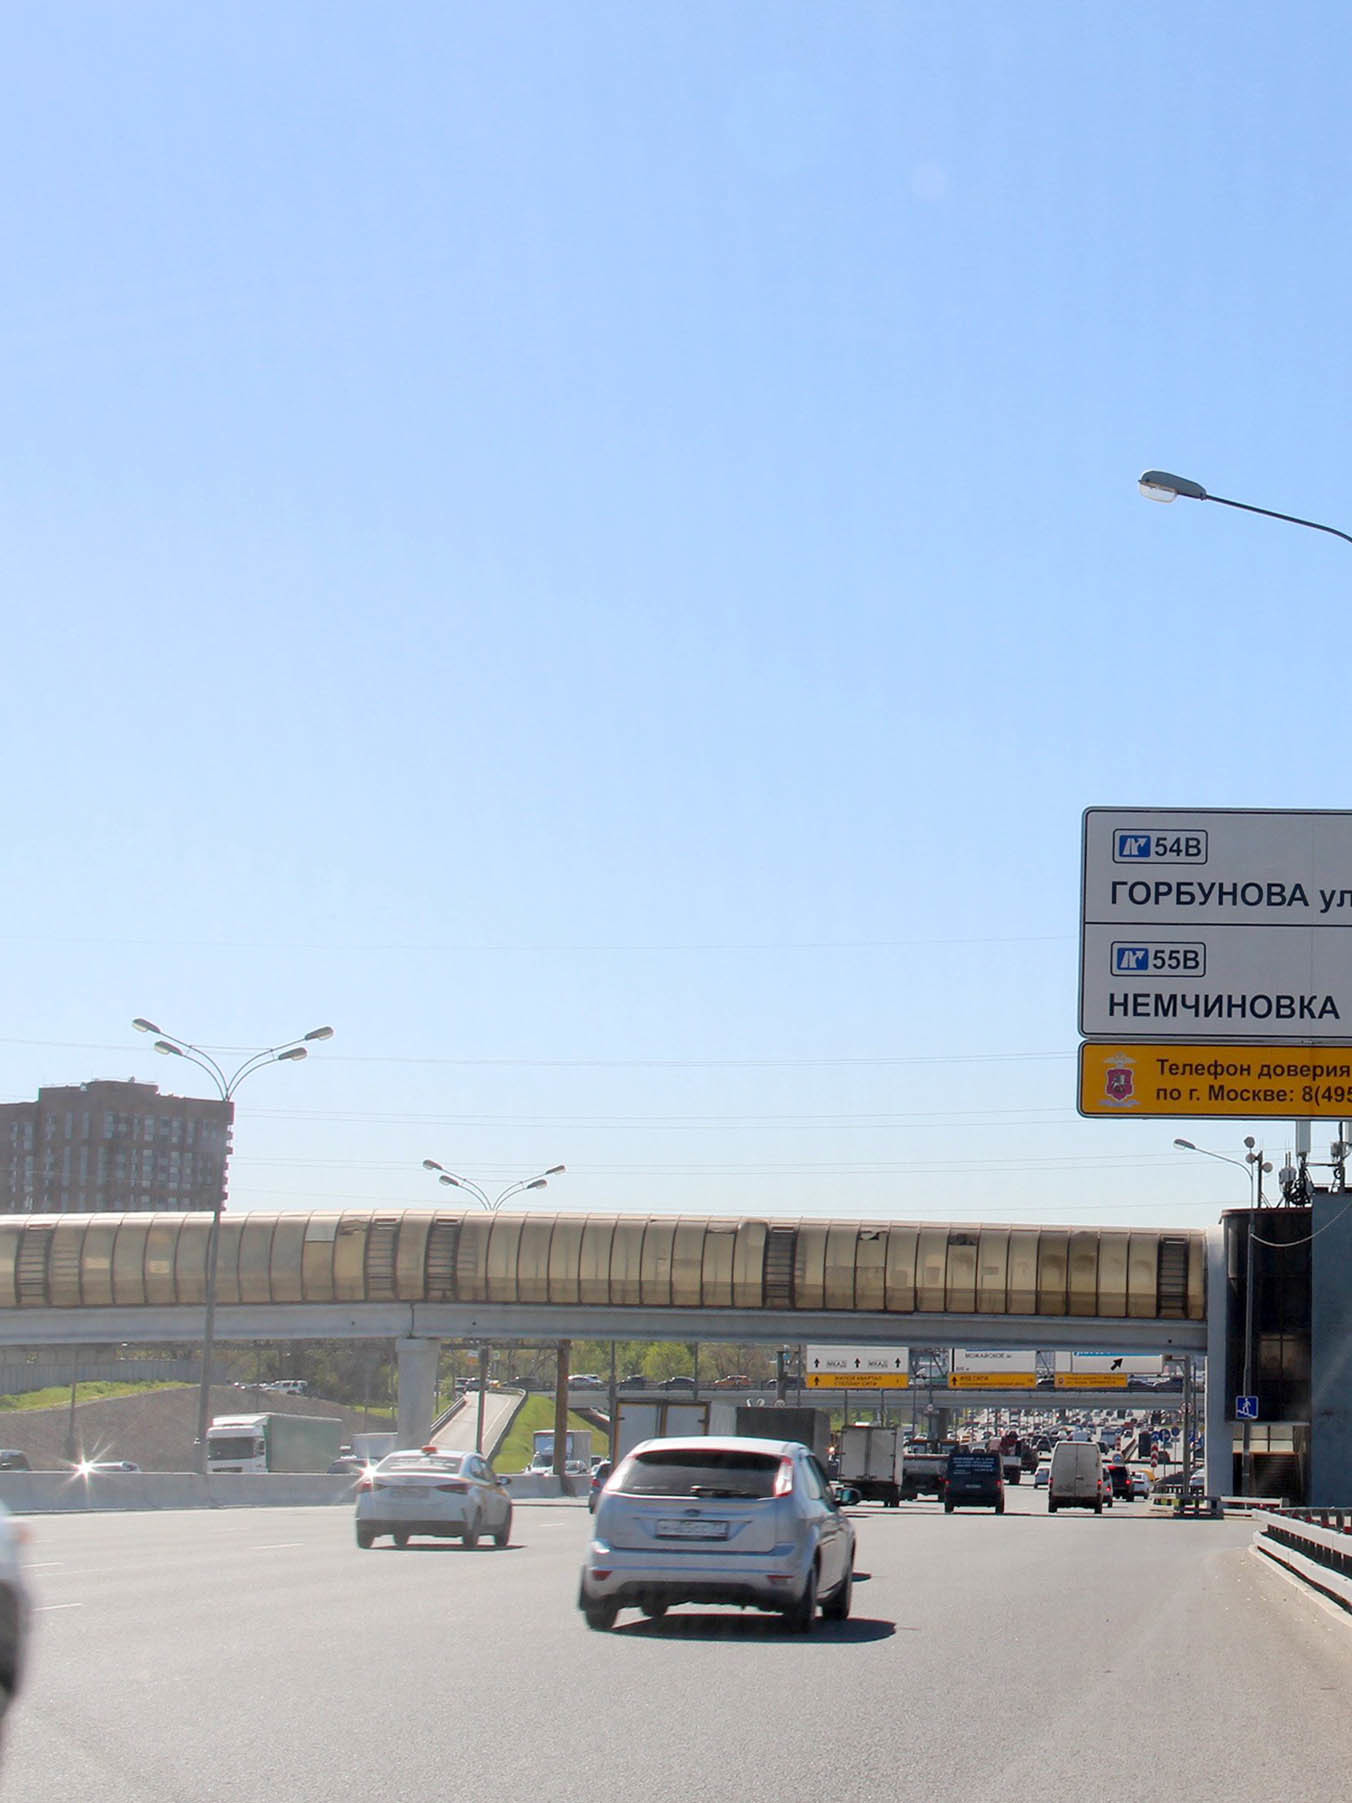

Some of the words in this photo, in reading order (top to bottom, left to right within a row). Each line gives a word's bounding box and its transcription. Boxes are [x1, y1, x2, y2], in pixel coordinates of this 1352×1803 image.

[1154, 837, 1201, 857] 54В
[1111, 881, 1309, 907] ГОРБУНОВА
[1152, 950, 1200, 970] 55В
[1108, 993, 1341, 1019] НЕМЧИНОВКА
[1156, 1058, 1251, 1080] Телефон
[1258, 1063, 1350, 1082] доверия
[1156, 1087, 1182, 1101] по
[1188, 1087, 1201, 1101] г.
[1208, 1084, 1295, 1102] Москве:
